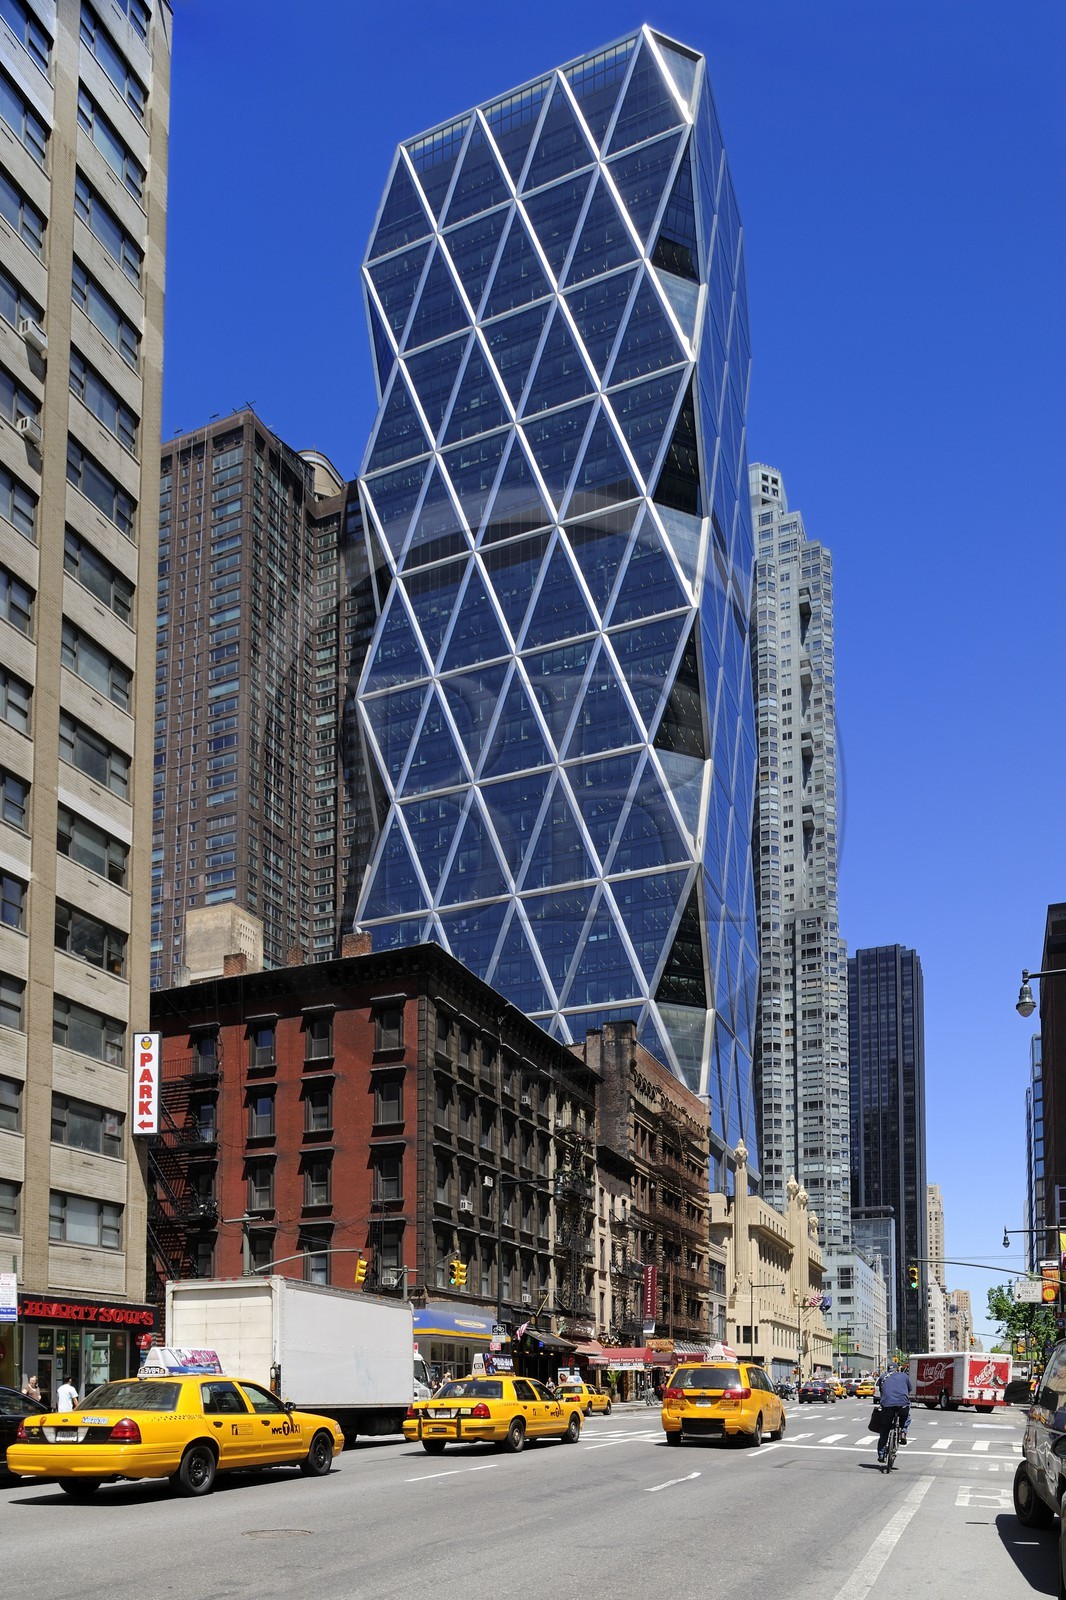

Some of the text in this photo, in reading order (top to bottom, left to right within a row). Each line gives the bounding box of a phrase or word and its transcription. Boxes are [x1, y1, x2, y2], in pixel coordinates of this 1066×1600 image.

[138, 1052, 154, 1116] PARK
[23, 1300, 98, 1321] HEARTY
[99, 1307, 154, 1326] SOUPS
[271, 1421, 300, 1436] NYC TAXI
